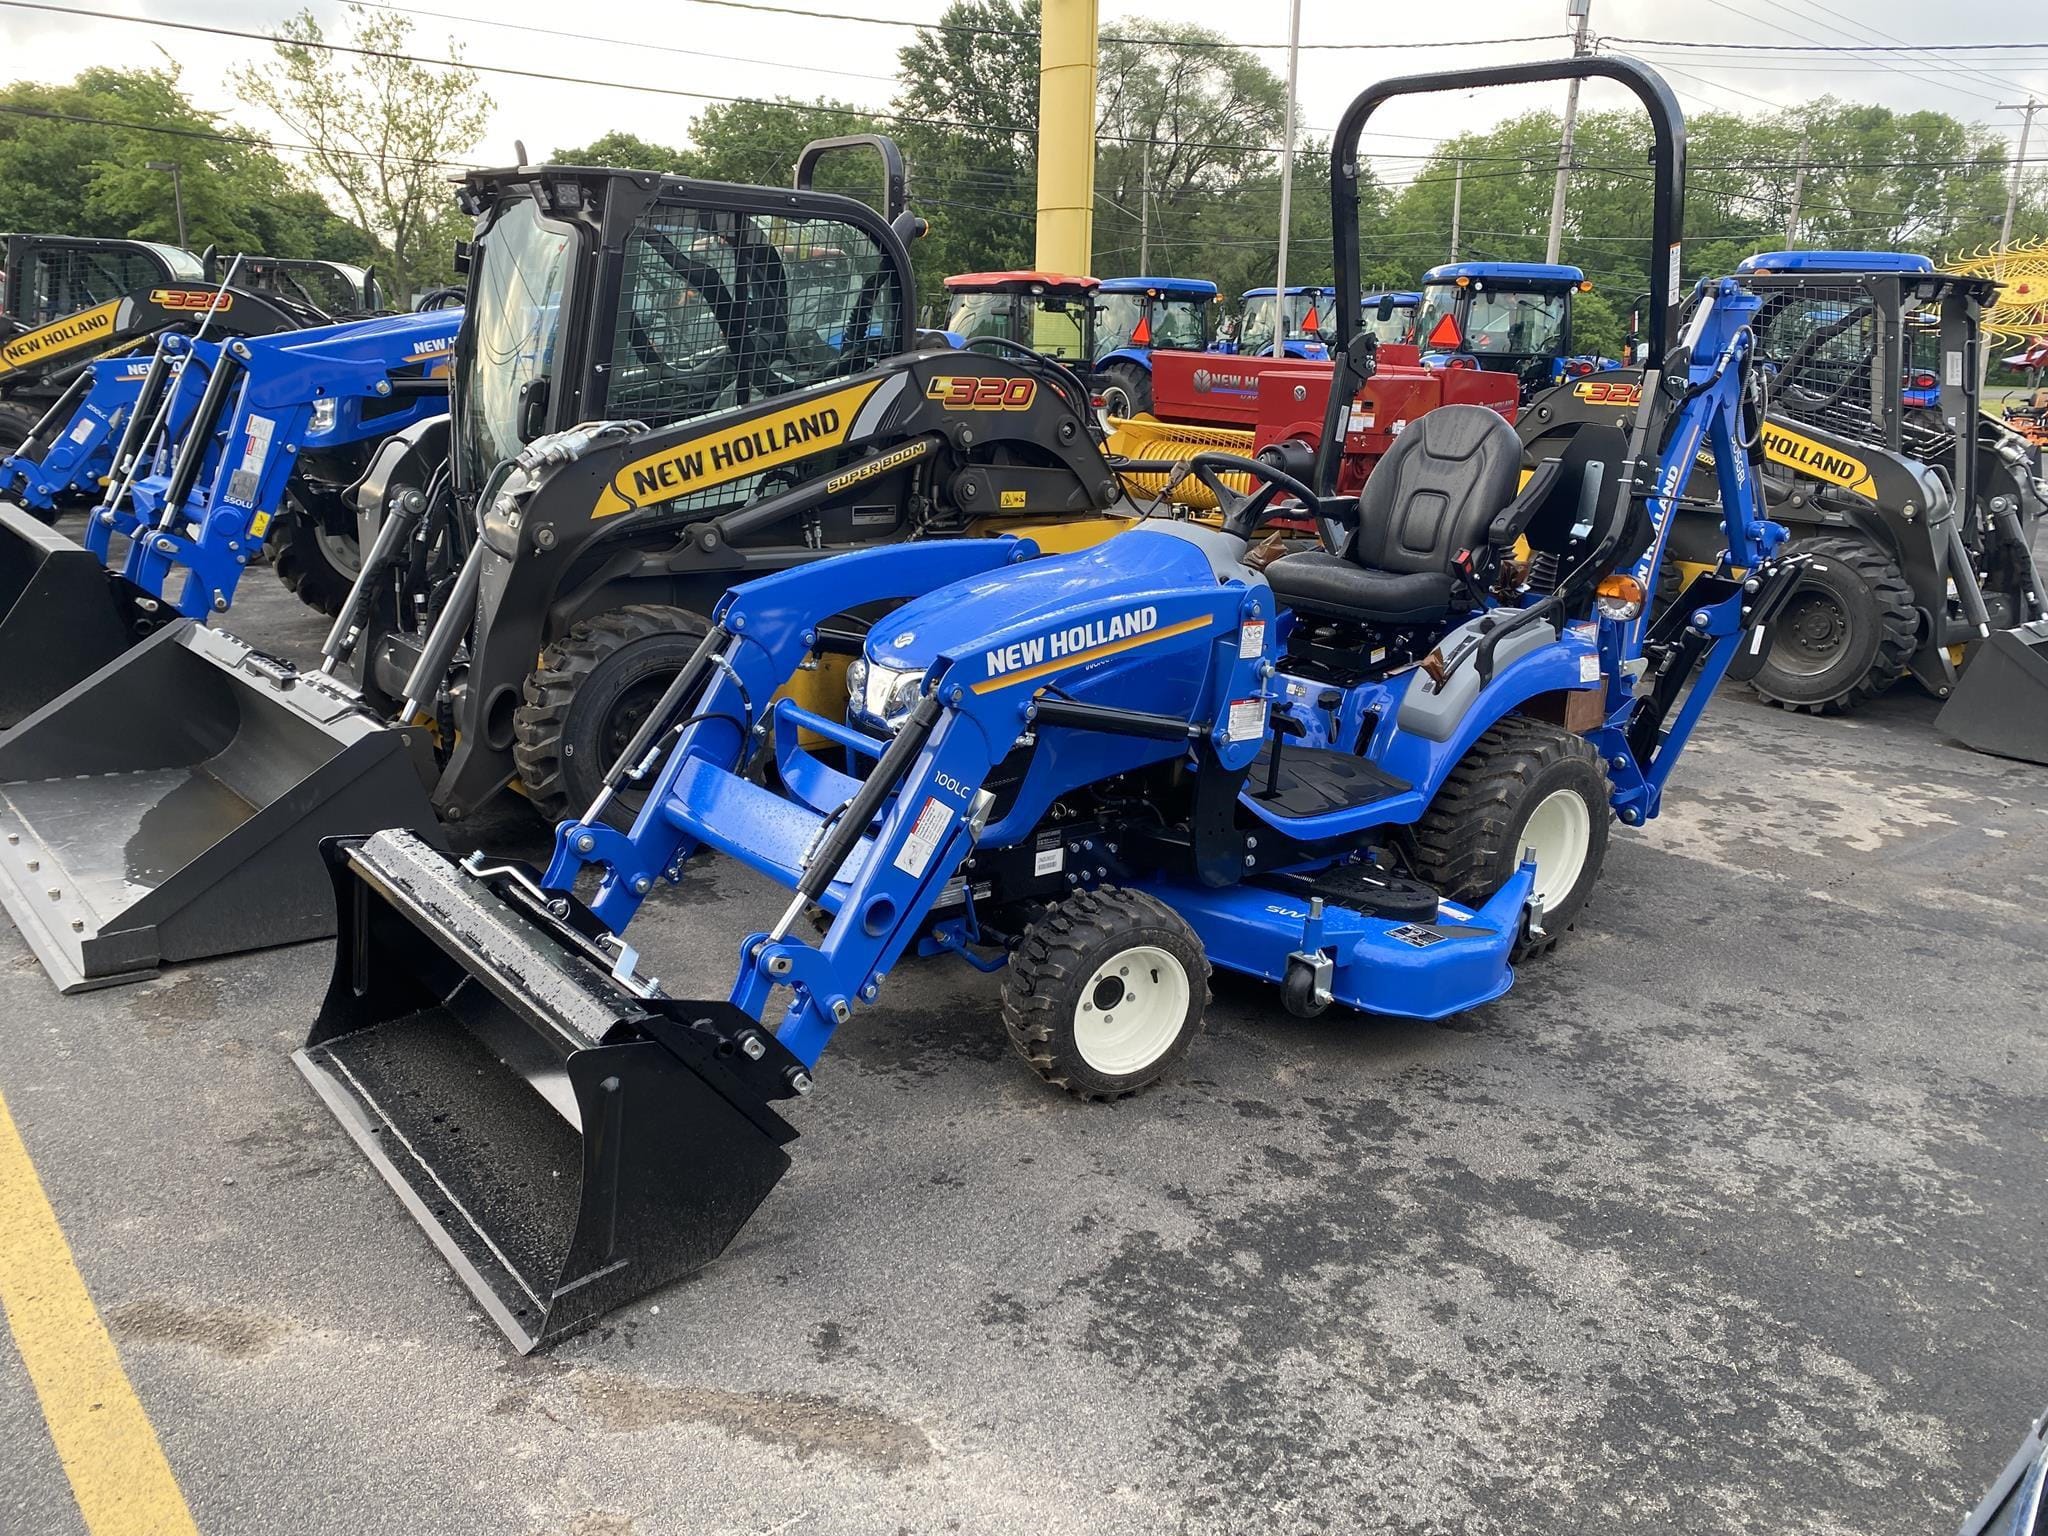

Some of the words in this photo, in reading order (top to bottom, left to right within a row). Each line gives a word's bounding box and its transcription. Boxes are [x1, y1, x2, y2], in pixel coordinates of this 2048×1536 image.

[150, 289, 232, 310] L328
[7, 337, 41, 360] NEW
[42, 313, 109, 347] HOLLAND
[413, 338, 446, 354] NEW
[927, 377, 1037, 409] L320
[1211, 373, 1241, 386] NEW
[633, 451, 704, 496] NEW
[710, 408, 840, 471] HOLLAND
[828, 462, 880, 493] SUPER
[881, 442, 926, 469] BOOM
[1763, 431, 1856, 480] HOLLAND
[1642, 465, 1679, 560] HLLAND
[986, 636, 1045, 677] NEW
[1050, 606, 1158, 658] HOLLAND
[934, 770, 971, 799] 100LC
